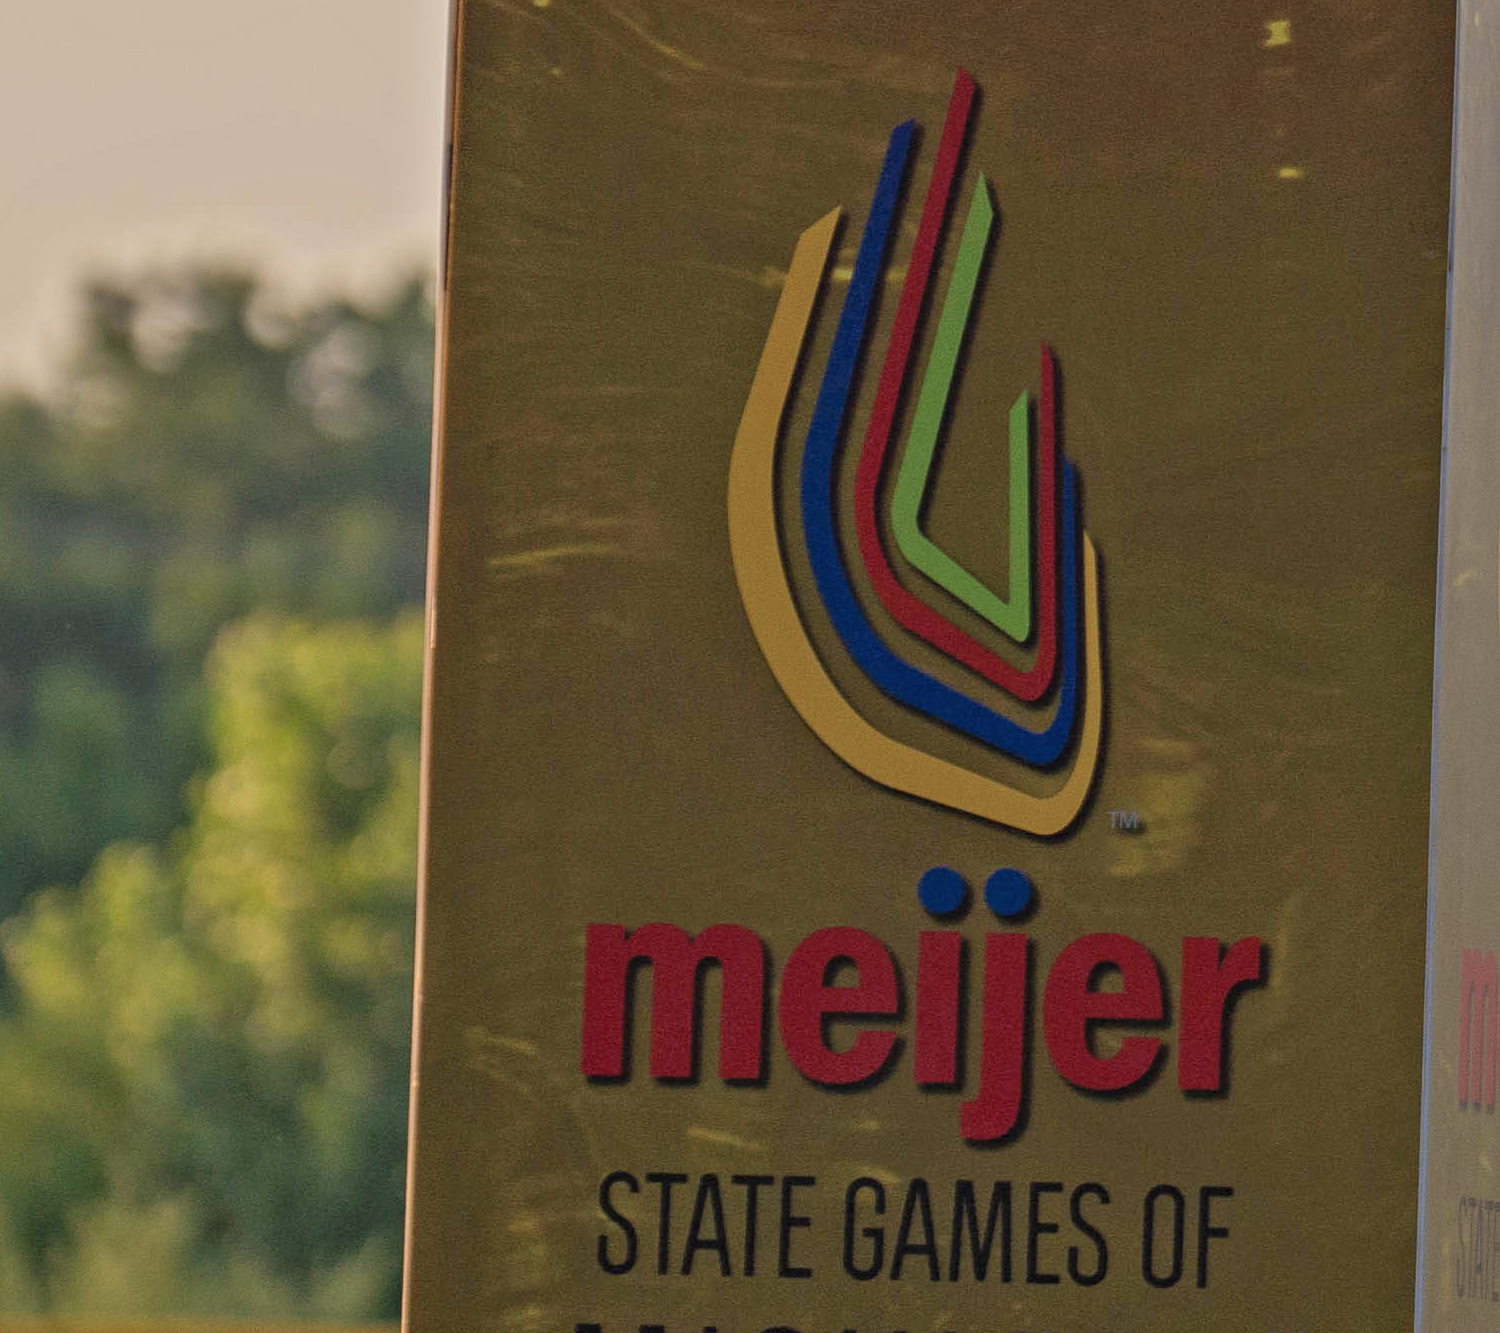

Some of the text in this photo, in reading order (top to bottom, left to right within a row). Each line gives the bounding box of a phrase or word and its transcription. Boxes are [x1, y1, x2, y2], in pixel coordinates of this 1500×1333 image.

[580, 867, 1262, 1142] meijer
[596, 1171, 1234, 1289] STATE GAMES OF
